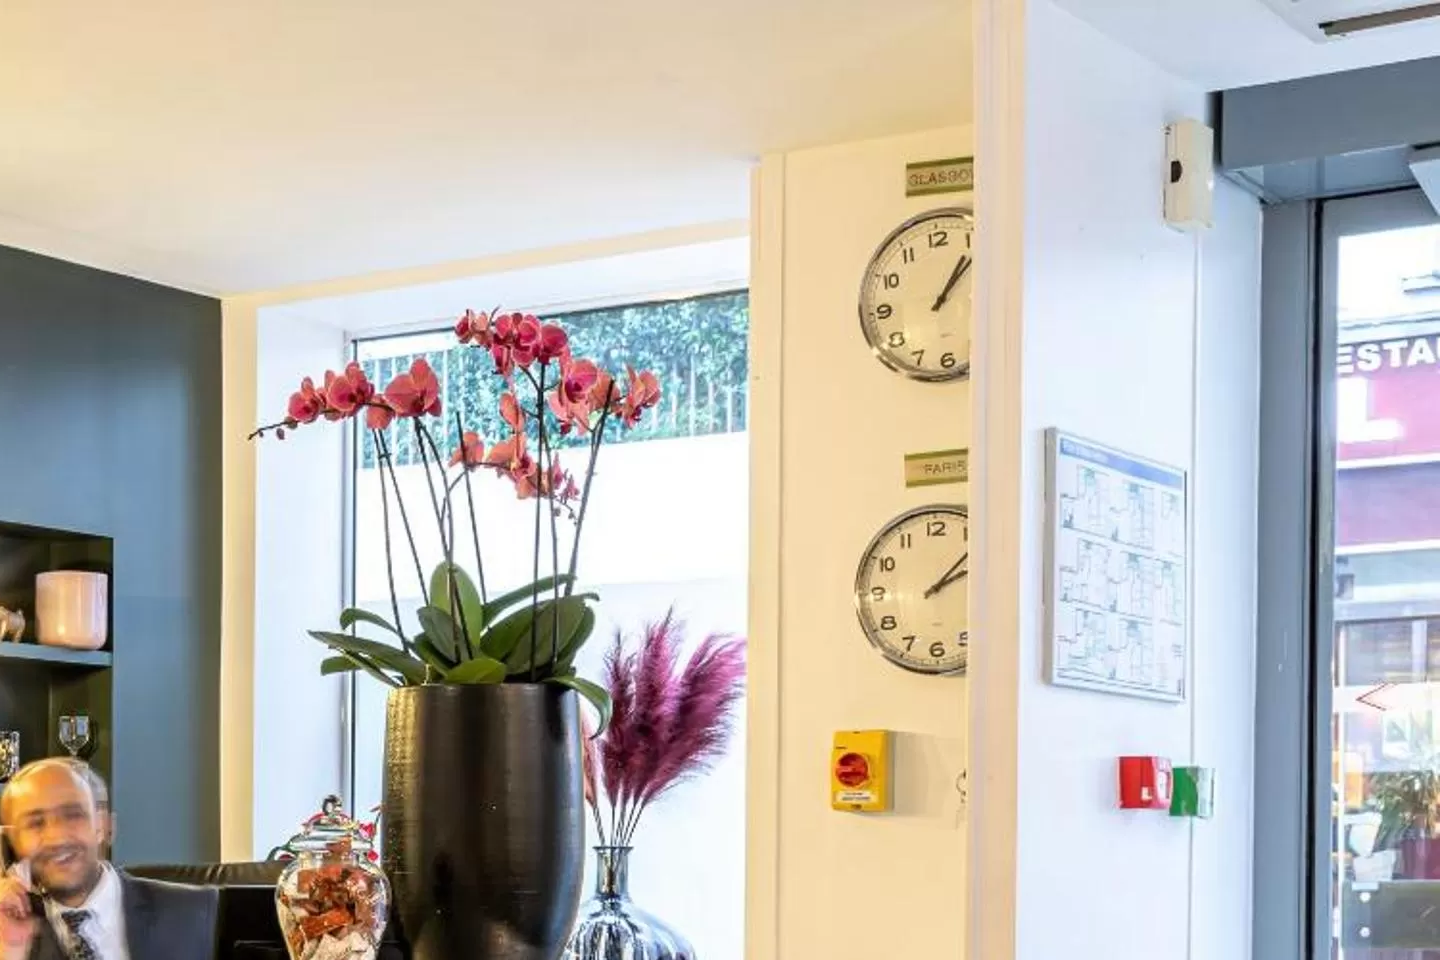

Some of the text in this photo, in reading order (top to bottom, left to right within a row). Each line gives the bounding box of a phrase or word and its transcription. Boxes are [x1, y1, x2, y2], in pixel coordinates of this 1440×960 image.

[908, 169, 973, 187] GLASGO
[929, 231, 948, 248] 12
[903, 247, 914, 264] 11
[884, 274, 899, 289] 10
[876, 305, 892, 319] 9
[889, 332, 905, 348] 8
[911, 349, 925, 366] 7
[940, 352, 956, 368] 6
[1337, 337, 1440, 374] ESTA
[927, 521, 946, 536] 12
[900, 533, 911, 549] 11
[879, 557, 896, 571] 10
[871, 586, 886, 601] 9
[881, 616, 897, 631] 8
[902, 635, 916, 651] 7
[929, 641, 945, 658] 6
